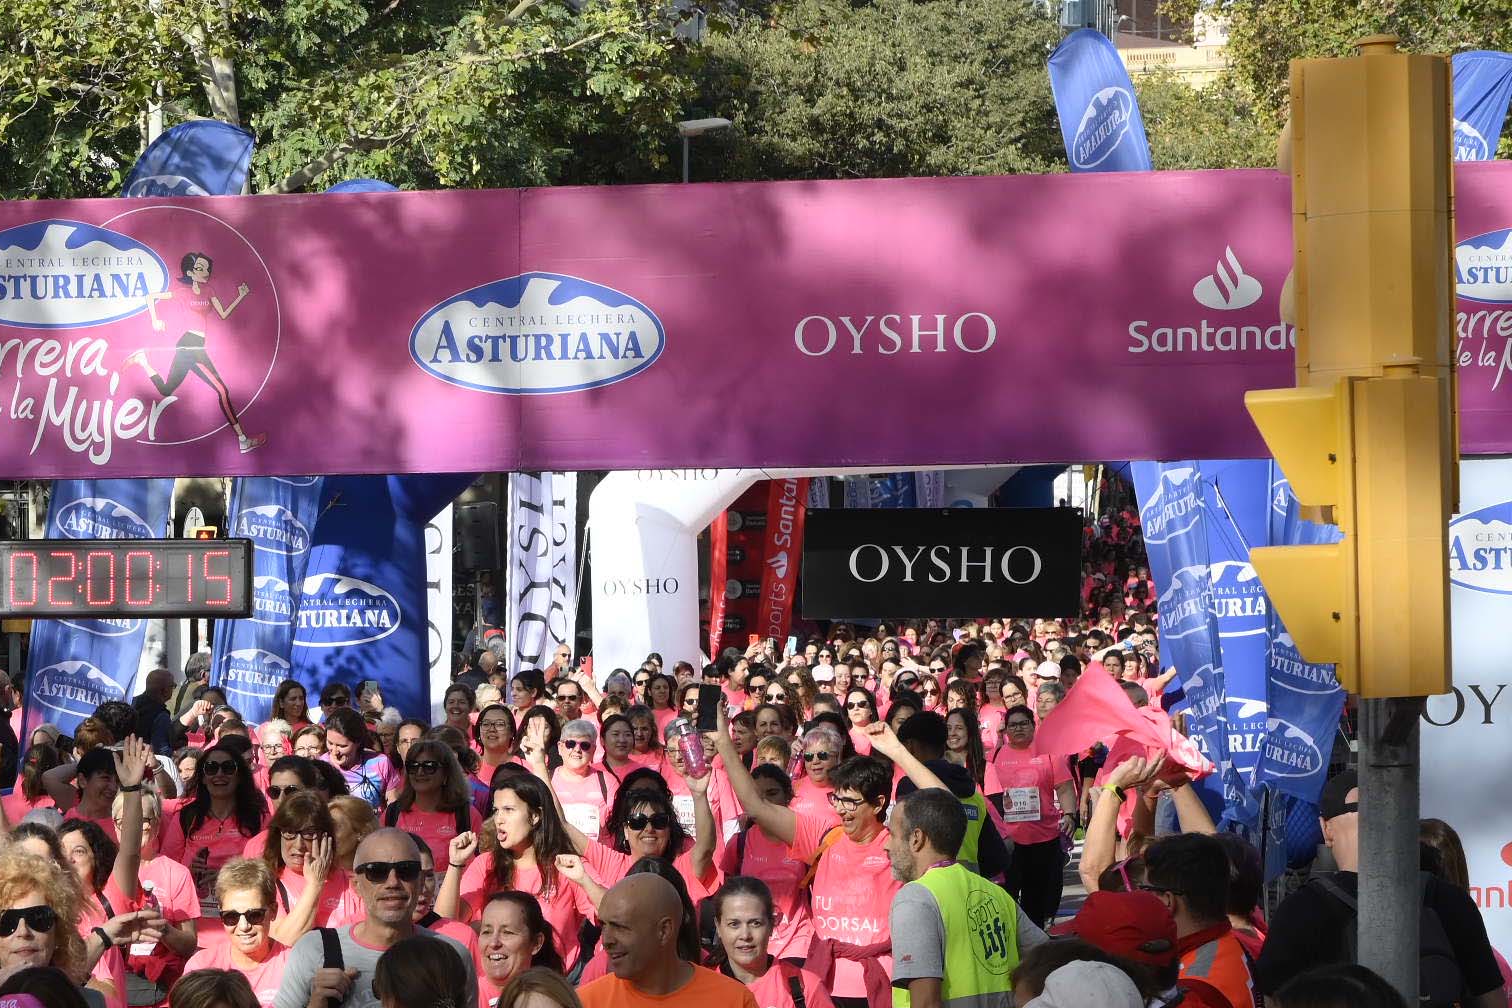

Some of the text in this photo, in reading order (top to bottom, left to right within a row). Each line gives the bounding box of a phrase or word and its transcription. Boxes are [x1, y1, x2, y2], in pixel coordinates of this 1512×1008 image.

[71, 253, 145, 268] LECHERA
[467, 311, 637, 328] CENTRAL LECHERA
[794, 311, 998, 357] OYSHO
[428, 317, 645, 364] ASTURIANA
[1127, 320, 1295, 354] Santand
[10, 380, 36, 420] la
[29, 372, 179, 466] Mujer
[237, 516, 304, 550] ASTURINA
[8, 551, 232, 606] 02:00:15
[847, 542, 1042, 585] OYSHO
[602, 576, 680, 597] OYSHO
[297, 609, 392, 629] TURIANA
[815, 895, 833, 911] TU
